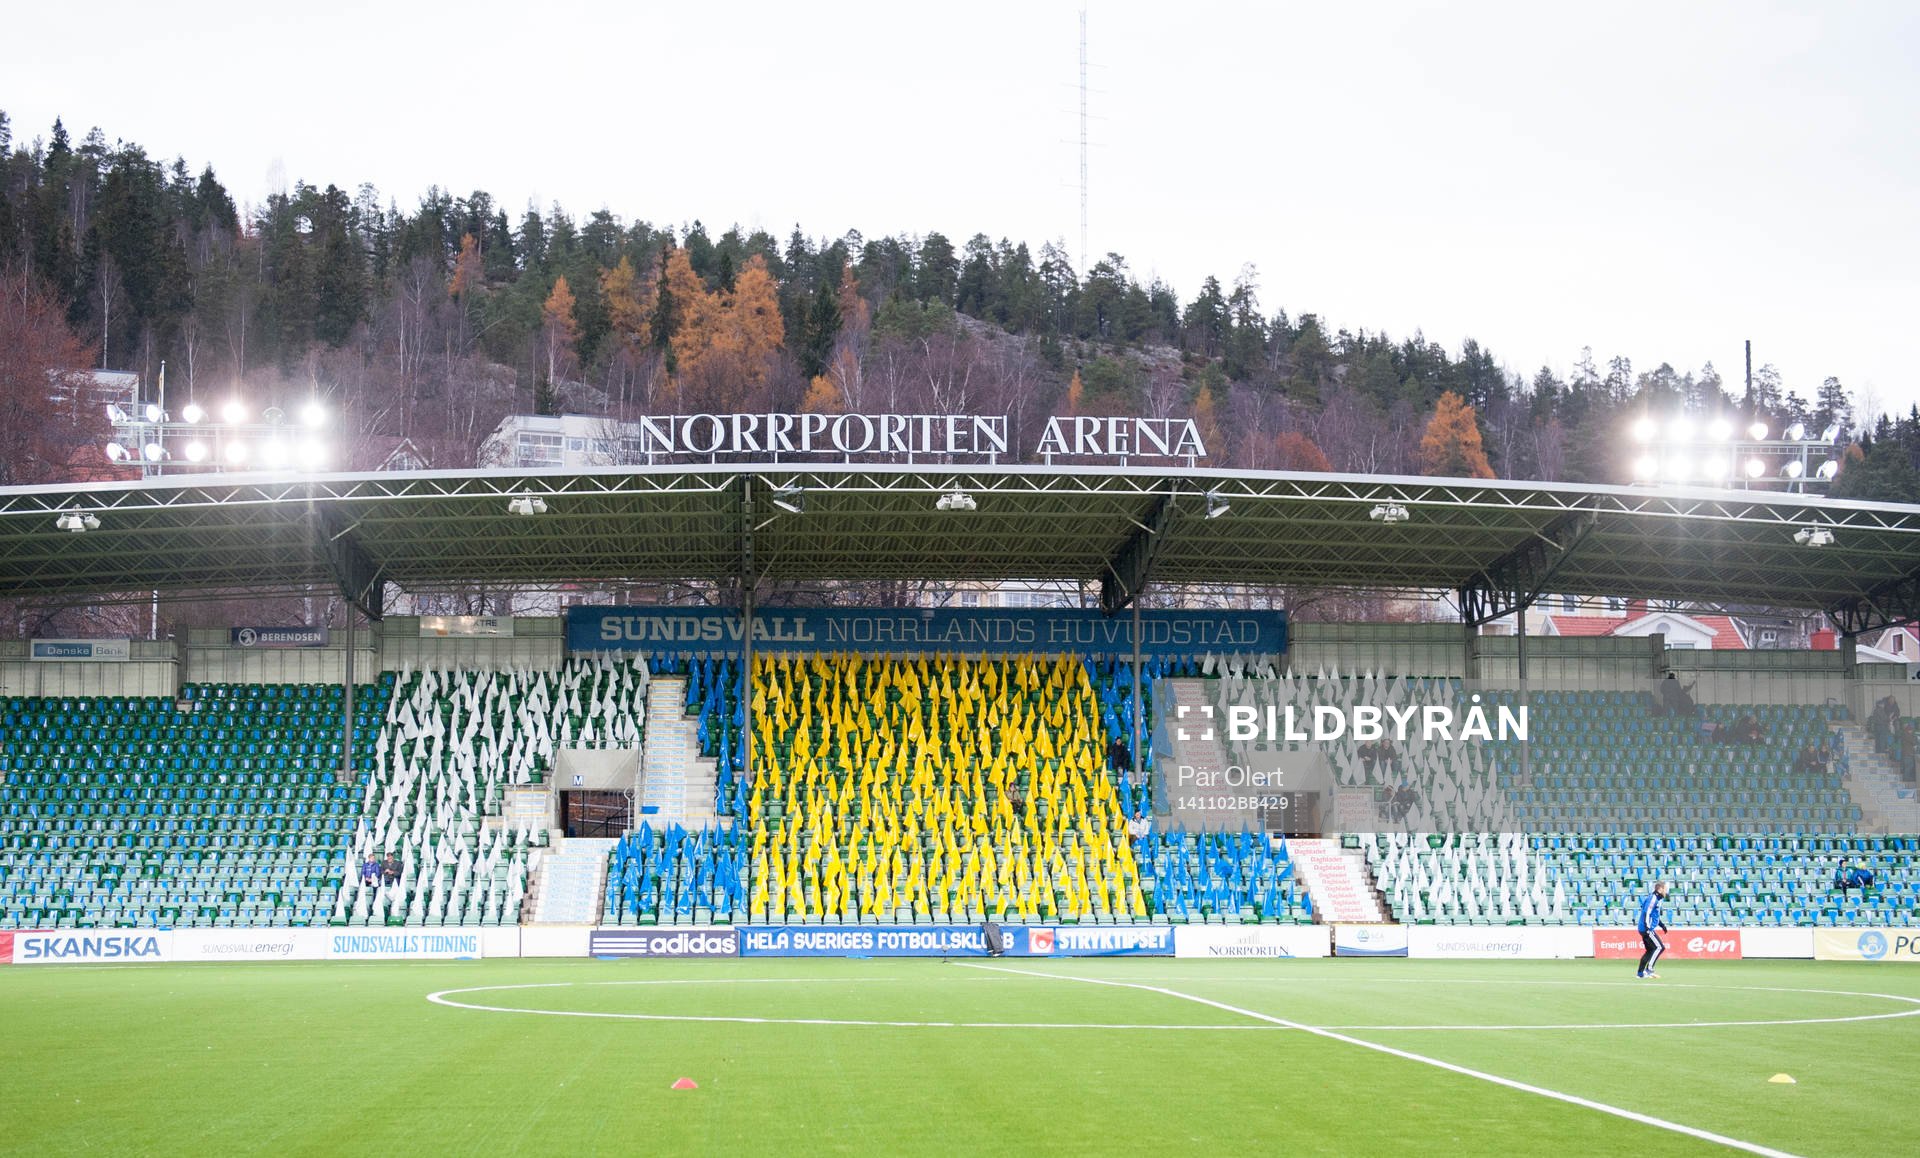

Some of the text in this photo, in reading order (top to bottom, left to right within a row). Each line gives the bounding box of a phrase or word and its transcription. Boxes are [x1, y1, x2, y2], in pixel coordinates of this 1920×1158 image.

[640, 413, 1208, 456] NORRPORTEN ARENA
[261, 632, 321, 642] BERENDSEN
[600, 616, 1260, 644] SUNDSVALL NORRLANDS HUVUDSTAD
[47, 646, 123, 655] Danske Bank
[573, 775, 583, 786] M
[23, 936, 162, 959] SKANSKA
[333, 935, 477, 953] SUNDSVALLS TIDNING
[650, 933, 736, 954] adidas
[747, 932, 1015, 950] HELA SVERIGES FOTBOLLSKLUB
[1058, 931, 1168, 950] STRYKTIPSET
[1600, 940, 1625, 951] Energi
[1627, 940, 1637, 950] till
[1208, 945, 1290, 956] NORRPORTEN
